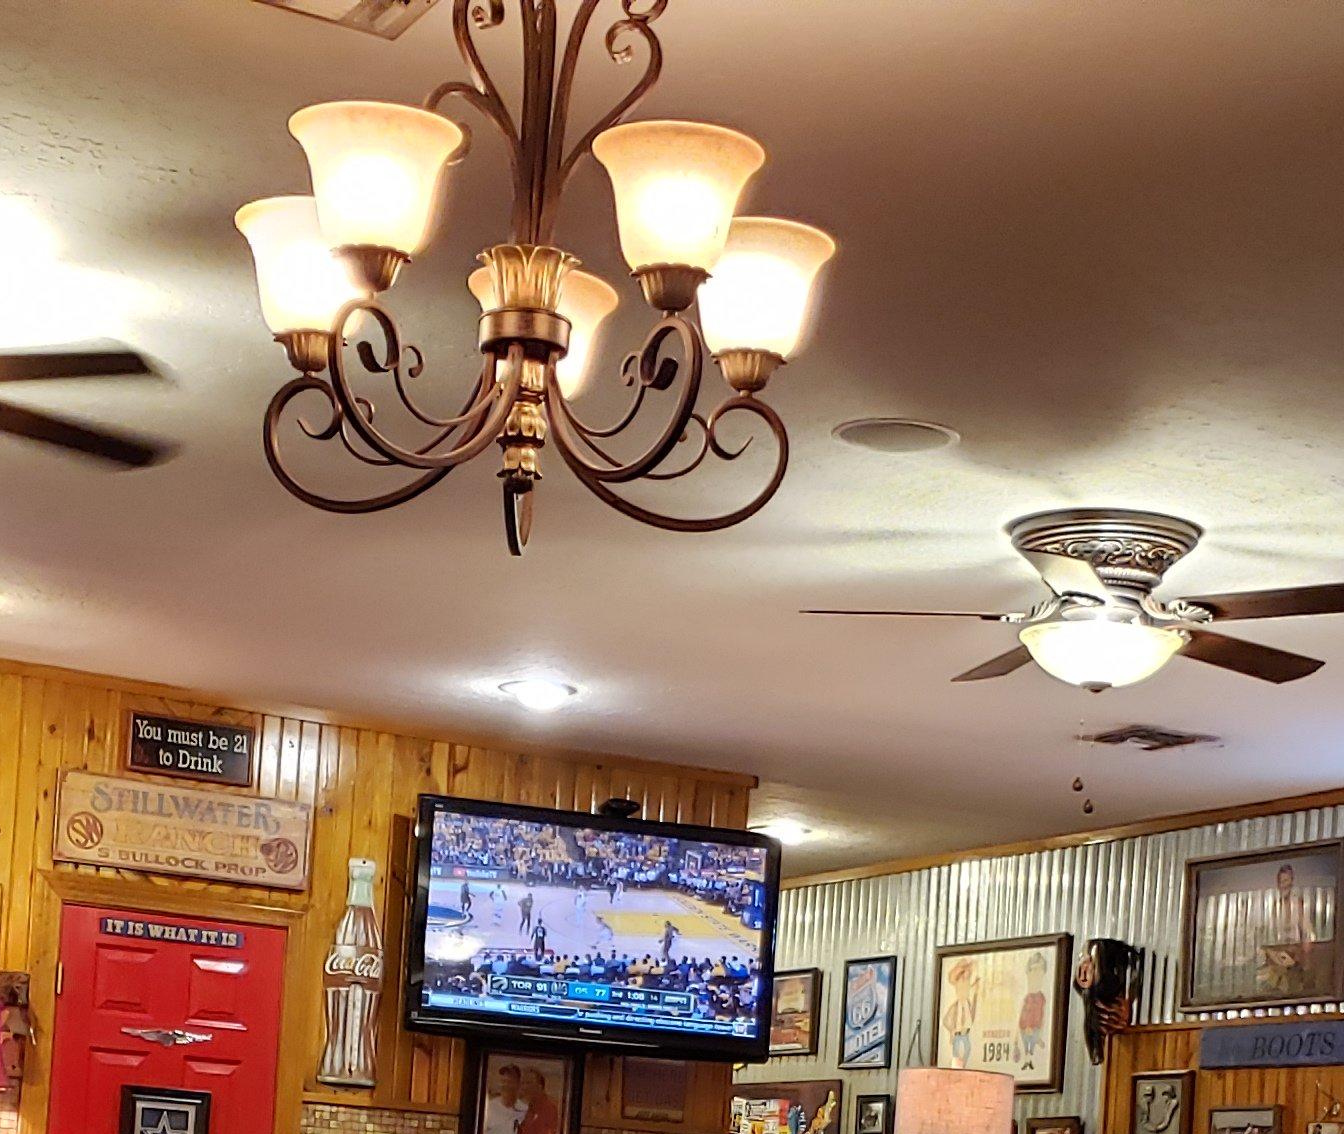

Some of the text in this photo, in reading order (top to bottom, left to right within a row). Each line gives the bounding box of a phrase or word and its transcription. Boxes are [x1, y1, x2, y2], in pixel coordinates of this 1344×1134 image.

[135, 718, 248, 754] You must be 21
[158, 748, 224, 775] to Drink
[89, 781, 281, 836] STILLWATER
[113, 816, 261, 860] RANCH
[118, 849, 209, 872] BULLOCK
[106, 918, 238, 946] IT IS WHAT IT IS
[511, 981, 533, 990] TOR
[536, 982, 548, 991] 91
[595, 988, 607, 997] 77
[982, 1042, 1010, 1063] 1984
[1251, 1031, 1337, 1059] BOOTS
